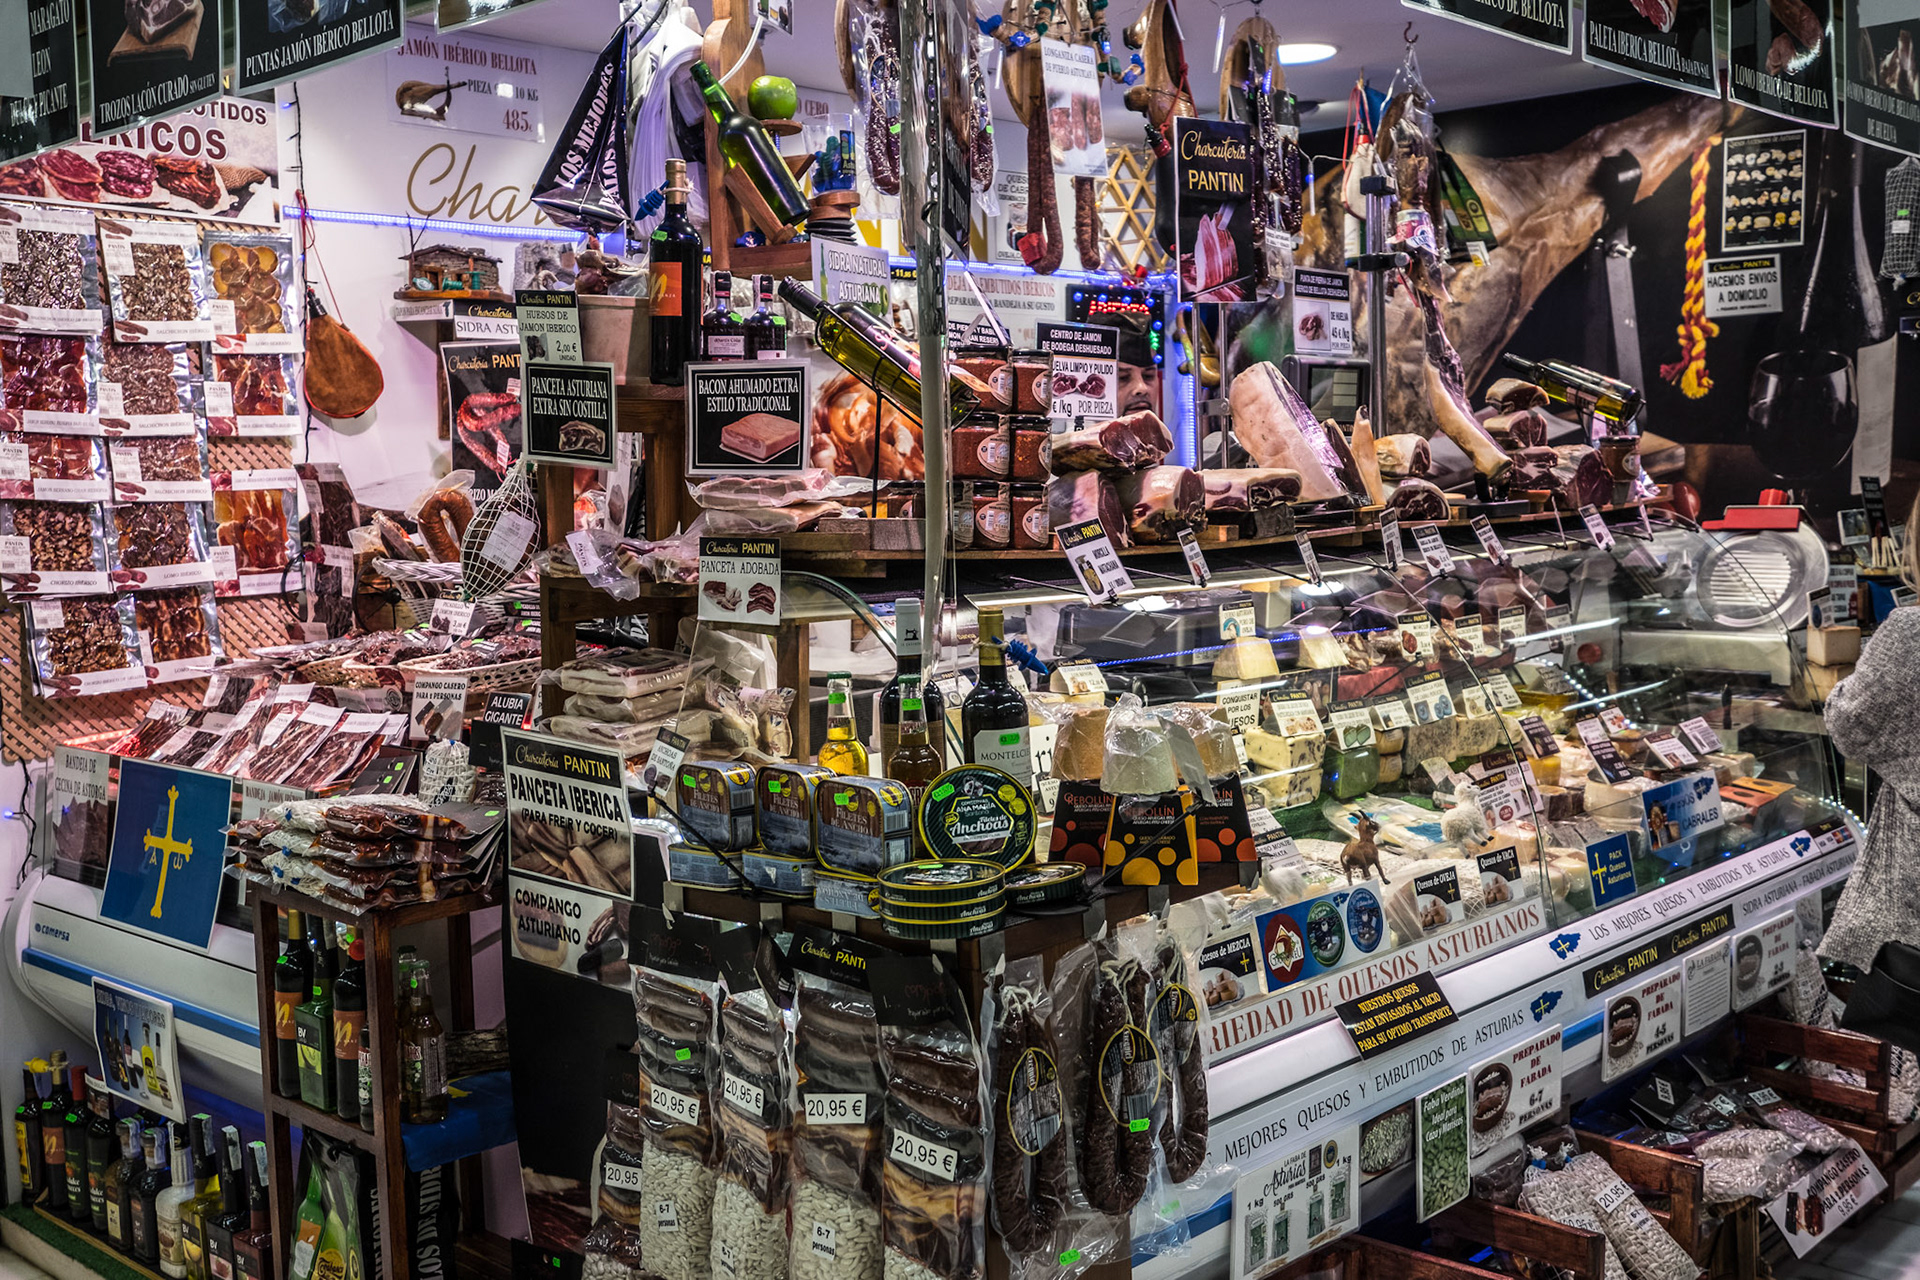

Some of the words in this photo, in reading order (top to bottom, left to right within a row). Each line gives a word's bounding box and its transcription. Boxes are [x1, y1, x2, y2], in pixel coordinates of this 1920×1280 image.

[29, 1, 71, 37] MARAGATO
[1506, 2, 1520, 18] DE
[1521, 5, 1565, 29] BELLOTA
[245, 48, 280, 77] PUNTAS
[281, 33, 312, 67] JAMÓN
[313, 19, 351, 57] IBÉRICO
[351, 9, 394, 42] BELLOTA
[398, 36, 439, 60] JAMÓN
[443, 41, 488, 68] IBÉRICO
[490, 53, 537, 76] BELLOTA
[467, 79, 493, 95] PIEZA
[515, 87, 526, 100] 10
[527, 88, 539, 102] KG
[1735, 63, 1755, 89] LOMO
[1783, 80, 1792, 100] DE
[1791, 81, 1828, 109] BELLOTA
[100, 94, 131, 124] TROZOS
[131, 81, 157, 116] LACÓN
[157, 74, 189, 107] CURADO
[553, 150, 585, 189] LOS
[580, 62, 615, 153] MEJORES
[999, 184, 1010, 195] DE
[1188, 169, 1245, 193] PANTIN
[828, 250, 851, 272] SIDRA
[851, 255, 888, 279] NATURAL
[1743, 259, 1771, 270] PANTIN
[1706, 273, 1745, 287] HACEMOS
[1749, 271, 1778, 285] ENVIOS
[546, 294, 572, 305] PANTIN
[838, 280, 882, 305] ASTURIANA
[1718, 292, 1725, 303] A
[1728, 288, 1768, 301] DOMICILIO
[526, 310, 554, 321] HUESOS
[557, 310, 569, 321] DE
[456, 321, 490, 333] SIDRA
[519, 322, 546, 333] JAMON
[546, 323, 577, 334] IBERICO
[1050, 329, 1074, 340] CENTRO
[1073, 331, 1082, 341] DE
[1082, 332, 1102, 343] JAMON
[555, 340, 570, 353] 2,00
[571, 343, 577, 353] €
[1042, 341, 1051, 350] DE
[1050, 341, 1075, 352] BODEGA
[1075, 343, 1113, 355] DESHUESADO
[559, 354, 576, 362] UNIDAD
[1069, 361, 1088, 373] LIMPIO
[1088, 363, 1094, 373] Y
[1094, 364, 1114, 375] PULIDO
[531, 376, 566, 397] PANCETA
[566, 378, 608, 399] ASTURIANA
[698, 379, 728, 395] BACON
[728, 378, 772, 395] AHUMADO
[772, 377, 799, 394] EXTRA
[533, 401, 559, 416] EXTRA
[559, 402, 572, 417] SIN
[572, 402, 608, 420] COSTILLA
[706, 397, 734, 413] ESTILO
[735, 395, 791, 412] TRADICIONAL
[1058, 399, 1073, 418] /kg
[1078, 400, 1093, 414] POR
[1094, 401, 1114, 414] PIEZA
[741, 543, 775, 554] PANTIN
[701, 561, 736, 574] PANCETA
[740, 561, 780, 575] ADOBADA
[415, 681, 444, 690] COMPANGO
[444, 681, 466, 691] CASERO
[1423, 672, 1441, 682] PANTIN
[490, 695, 524, 710] ALUBIA
[1222, 693, 1258, 705] CONQUISTAR
[1290, 691, 1308, 700] PANTIN
[1227, 705, 1239, 713] POR
[1240, 703, 1251, 712] LOS
[484, 710, 524, 726] GIGANTE
[65, 755, 88, 772] BANDEJA
[88, 759, 97, 773] DE
[54, 778, 73, 793] CECINA
[73, 780, 81, 794] DE
[81, 783, 107, 801] ASTORGA
[509, 772, 568, 816] PANCETA
[568, 784, 625, 823] IBERICA
[972, 802, 996, 811] MARÍA
[835, 806, 868, 826] FILETES
[1681, 807, 1720, 830] CABRALES
[521, 807, 548, 824] (PARA
[548, 813, 575, 831] FREIR
[574, 819, 582, 832] Y
[582, 821, 618, 844] COCER)
[949, 819, 1009, 837] Anchoas
[1480, 855, 1496, 869] Quesos
[1496, 853, 1502, 862] de
[1608, 848, 1623, 861] PACK
[1608, 861, 1627, 873] Quesos
[1416, 878, 1433, 892] Quesos
[1433, 876, 1440, 886] de
[1440, 870, 1456, 883] OVEJA
[1588, 923, 1611, 941] LOS
[1612, 907, 1651, 933] MEJORES
[1653, 891, 1686, 917] QUESOS
[1687, 887, 1697, 899] Y
[1699, 867, 1743, 896] EMBUTIDOS
[1745, 862, 1756, 875] DE
[1758, 847, 1790, 870] ASTURIAS
[515, 888, 582, 919] COMPANGO
[41, 925, 71, 942] comersa
[518, 914, 581, 945] ASTURIANO
[1199, 948, 1219, 965] Quesos
[1219, 945, 1227, 957] de
[1226, 937, 1251, 956] MEZCLA
[1627, 946, 1659, 972] PANTIN
[1700, 913, 1729, 938] PANTIN
[1209, 998, 1295, 1055] RIEDAD
[1302, 981, 1332, 1016] DE
[1337, 950, 1420, 1001] QUESOS
[1426, 904, 1540, 969] ASTURIANOS
[1353, 1017, 1376, 1035] ESTAN
[1376, 1002, 1412, 1028] ENVASADOS
[1412, 1000, 1421, 1011] AL
[1421, 992, 1442, 1009] VACIO
[297, 1027, 307, 1039] BV
[1357, 1035, 1377, 1053] PARA
[1377, 1033, 1386, 1045] SU
[1386, 1019, 1411, 1041] OPTIMO
[1410, 1005, 1453, 1033] TRANSPORTE
[1512, 1031, 1561, 1064] PREPARADO
[1530, 1055, 1541, 1069] DE
[1224, 1118, 1288, 1163] MEJORES
[1297, 1089, 1351, 1130] QUESOS
[1358, 1082, 1367, 1100] Y
[1374, 1046, 1445, 1093] EMBUTIDOS
[1451, 1035, 1468, 1056] DE
[1474, 1009, 1524, 1045] ASTURIAS
[1519, 1065, 1552, 1089] FABADA
[724, 1077, 752, 1101] 20,95
[754, 1096, 762, 1110] €
[1529, 1088, 1544, 1107] 6-7
[652, 1090, 685, 1114] 20,95
[687, 1102, 697, 1118] €
[807, 1099, 847, 1118] 20,95
[851, 1102, 863, 1117] €
[1518, 1099, 1553, 1126] PERSONAS
[894, 1135, 938, 1167] 20,95
[942, 1154, 954, 1173] €
[606, 1166, 639, 1186] 20,95
[1263, 1160, 1307, 1198] Asturias
[1600, 1184, 1623, 1209] 20,95
[1622, 1180, 1630, 1192] €
[658, 1203, 670, 1215] 6-7
[182, 1223, 190, 1234] BV
[657, 1217, 676, 1228] personas
[815, 1225, 831, 1240] 6-7
[209, 1238, 219, 1250] BV
[812, 1239, 835, 1257] personas
[236, 1254, 246, 1265] BV
